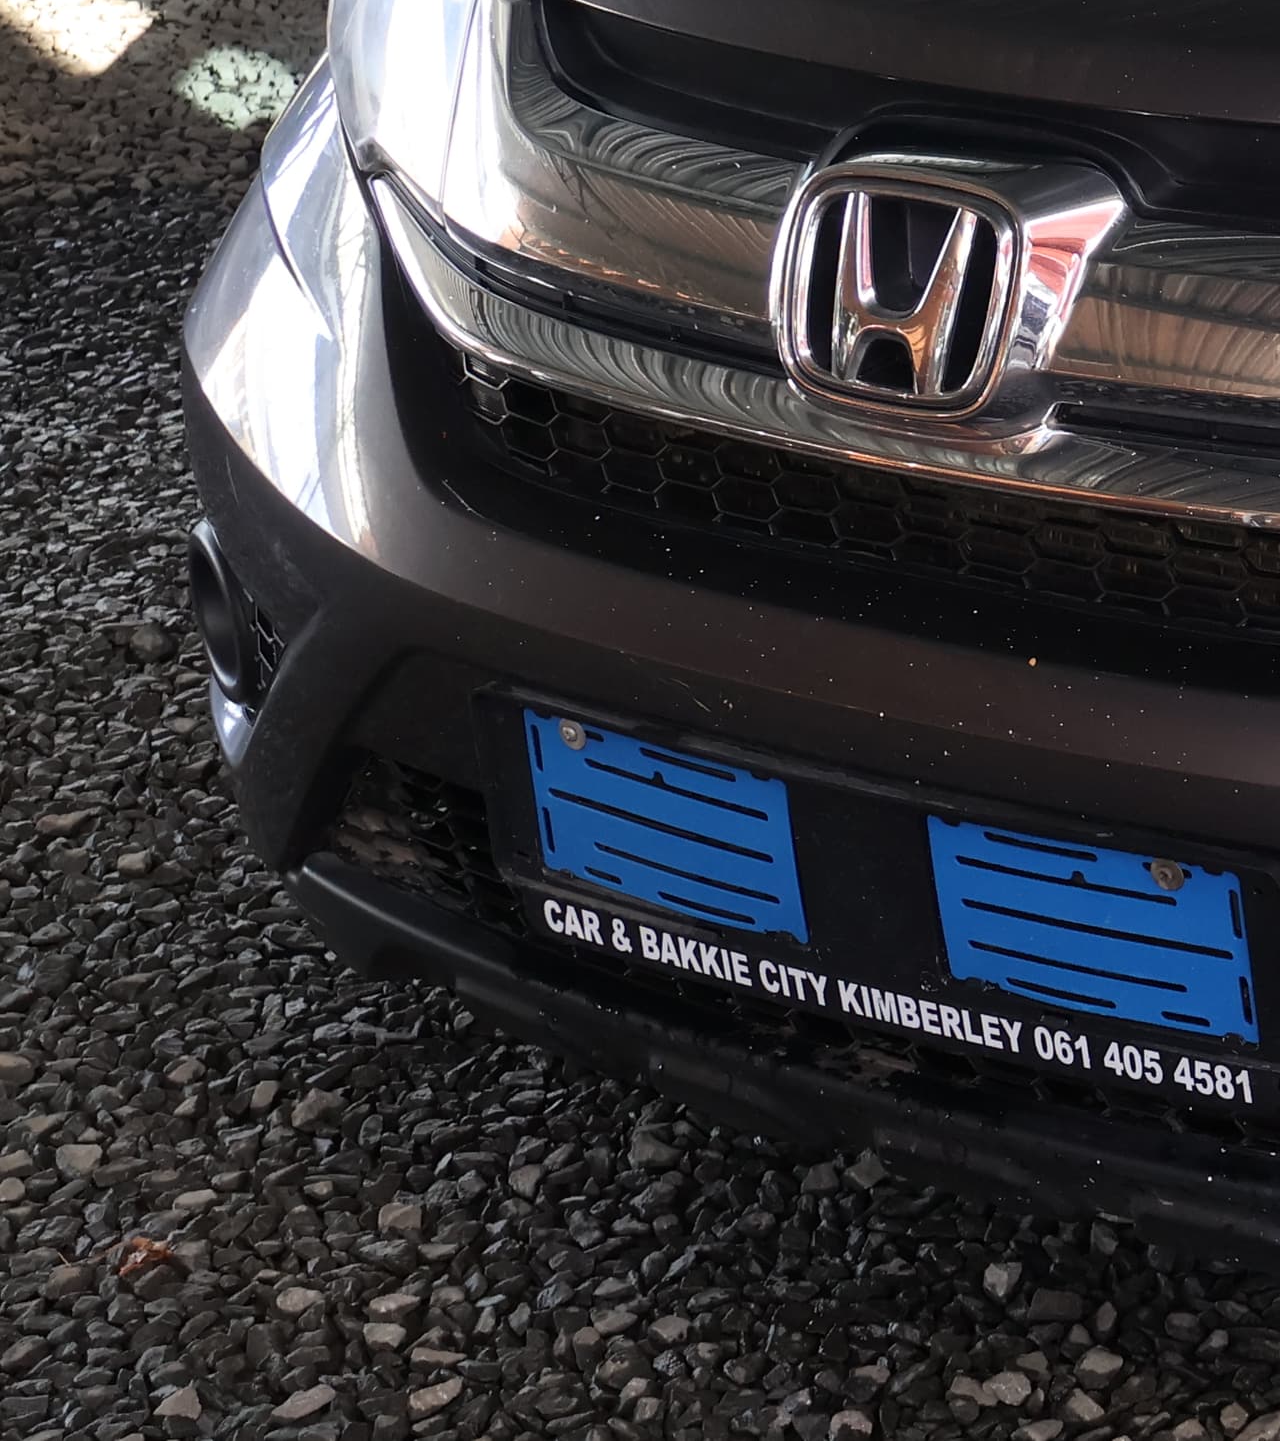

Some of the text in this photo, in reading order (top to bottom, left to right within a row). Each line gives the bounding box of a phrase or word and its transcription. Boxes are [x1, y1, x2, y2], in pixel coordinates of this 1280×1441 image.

[541, 898, 1254, 1105] CAR & BAKKIE CITY KIMBERLEY 061 405 4581
